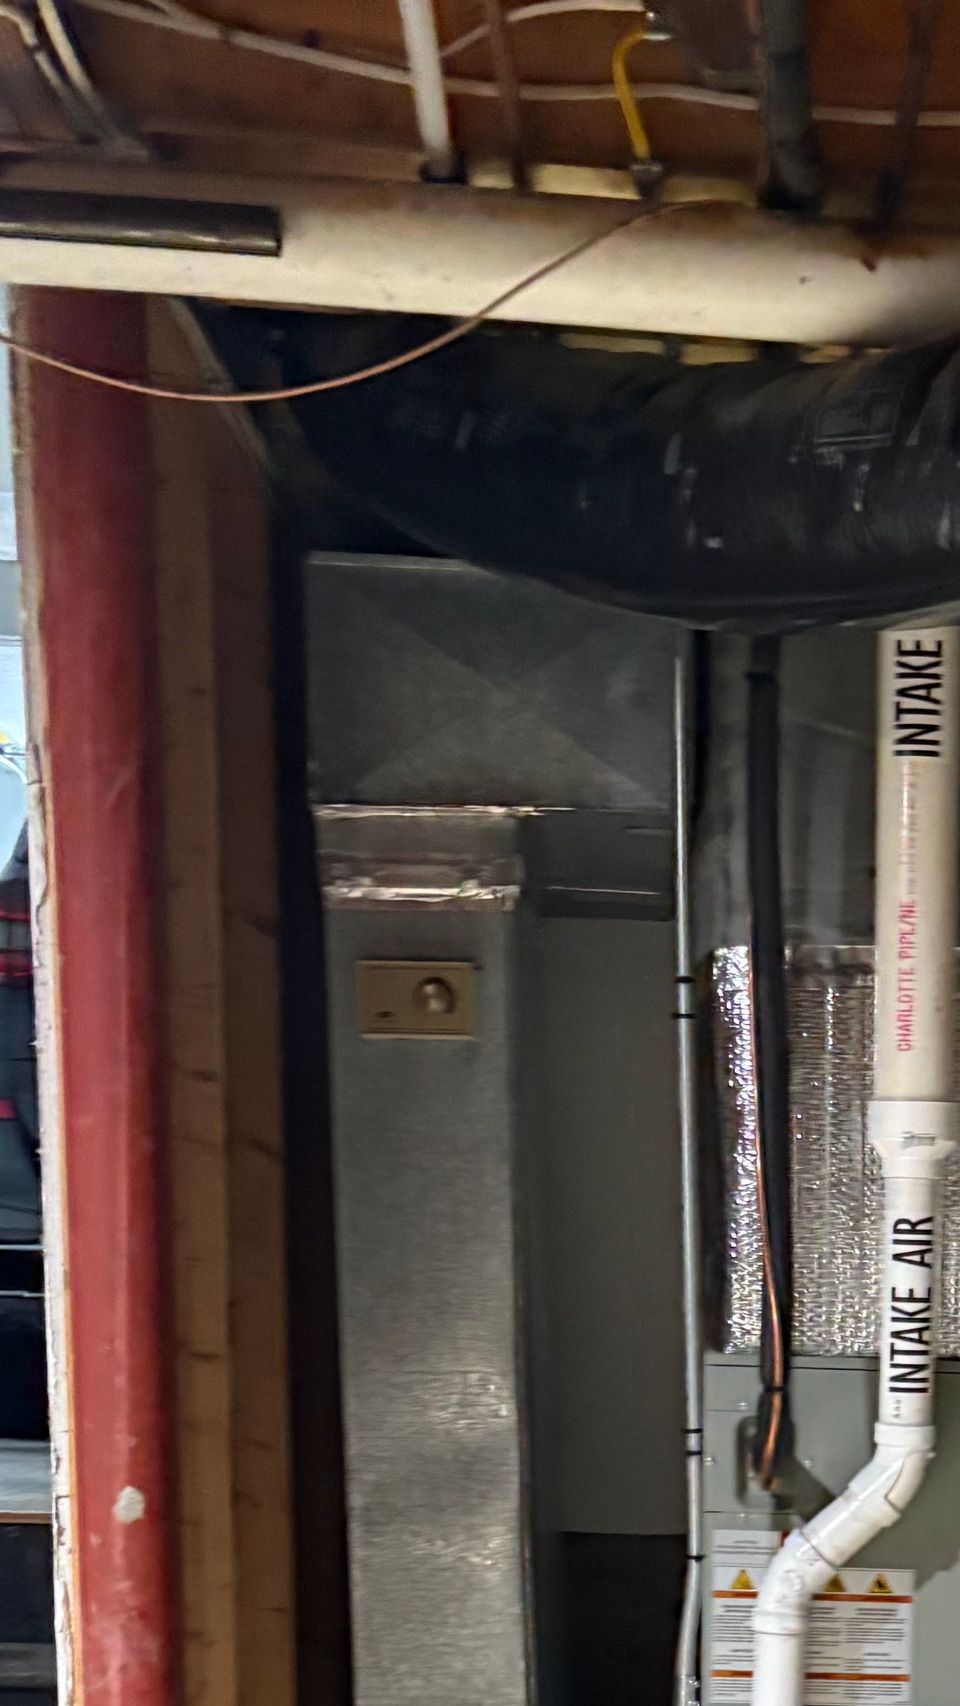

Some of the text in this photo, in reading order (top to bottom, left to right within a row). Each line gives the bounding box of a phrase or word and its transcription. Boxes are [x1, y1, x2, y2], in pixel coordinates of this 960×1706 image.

[893, 640, 943, 757] INTAKE
[896, 967, 917, 1052] CHARLOTTE
[889, 1215, 934, 1393] INTAKE AIR
